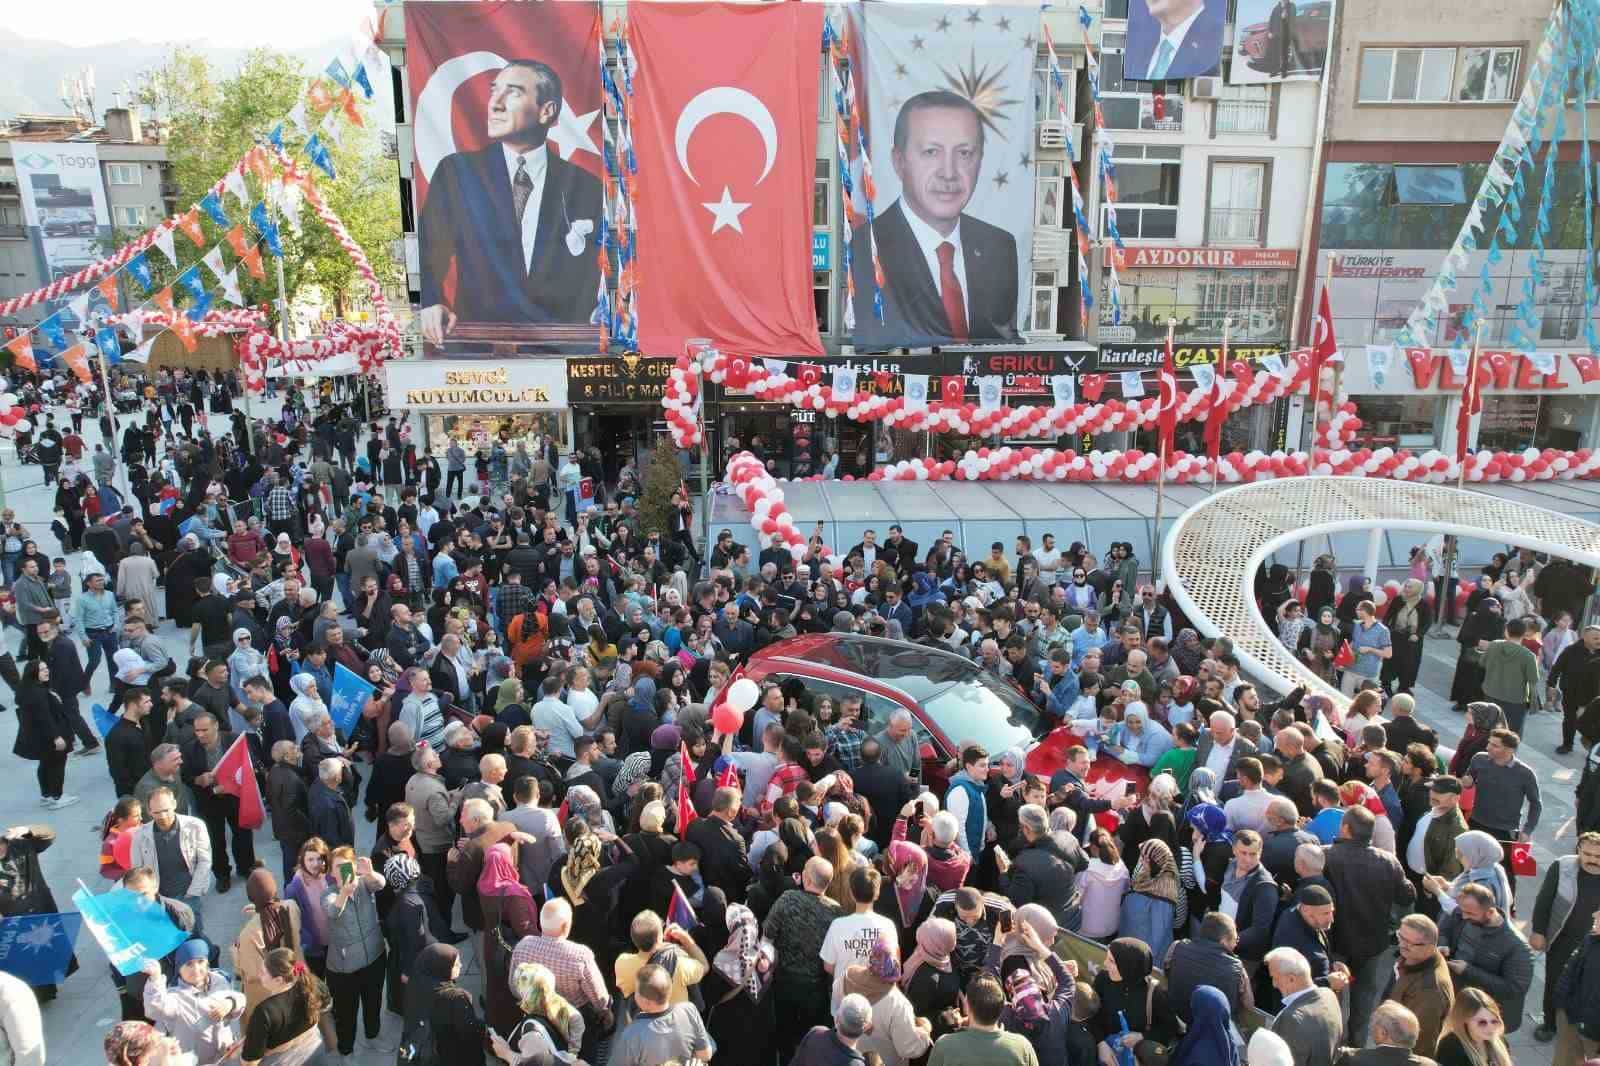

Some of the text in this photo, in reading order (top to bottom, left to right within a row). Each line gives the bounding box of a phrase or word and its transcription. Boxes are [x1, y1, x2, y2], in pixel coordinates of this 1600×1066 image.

[56, 153, 97, 168] Togg
[1135, 249, 1235, 266] AYDOKUR
[1100, 348, 1173, 366] Kardeşle
[570, 361, 676, 378] KESTEL CİĞ
[584, 384, 594, 398] &
